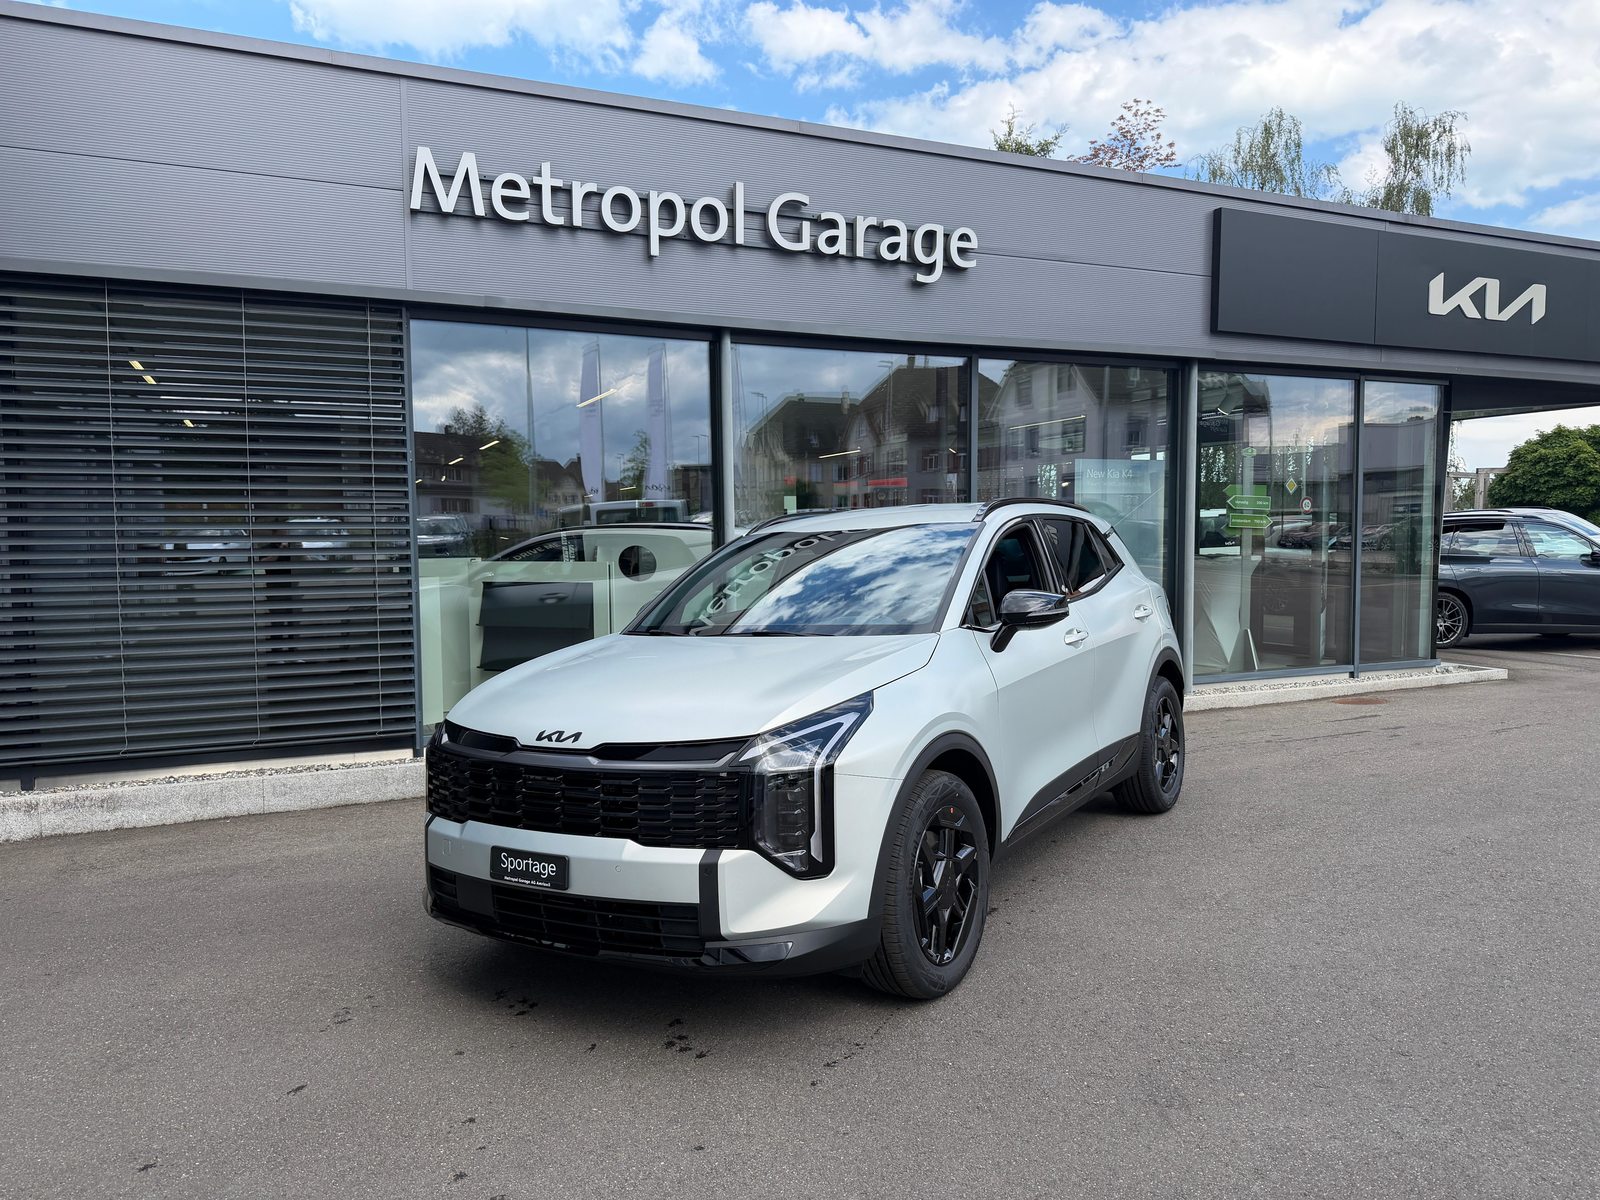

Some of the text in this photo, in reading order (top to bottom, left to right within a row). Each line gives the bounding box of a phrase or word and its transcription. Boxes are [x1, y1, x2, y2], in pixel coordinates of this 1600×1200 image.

[410, 146, 978, 284] Metropol Garage
[1428, 271, 1547, 325] KIA
[1086, 468, 1133, 479] New Kia K4
[513, 546, 545, 560] DRIVE
[535, 729, 583, 744] KIA
[500, 852, 556, 878] Sportage
